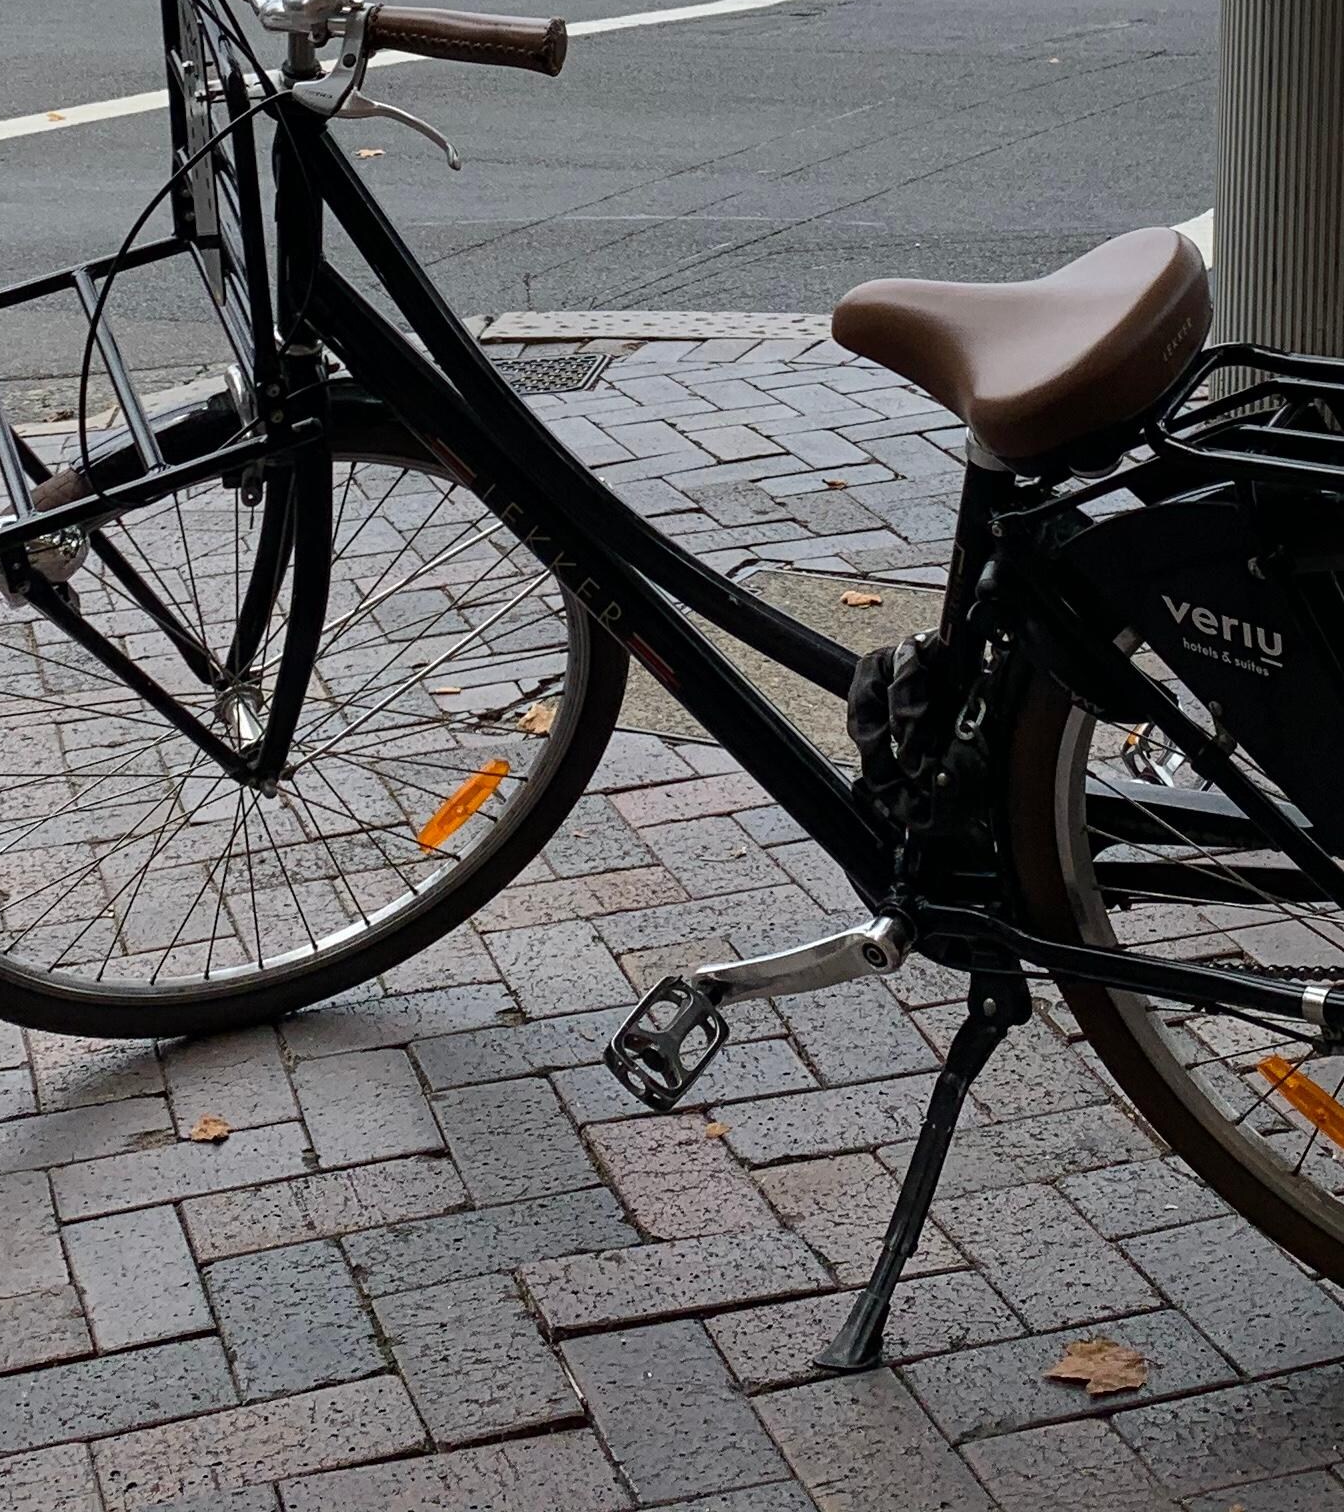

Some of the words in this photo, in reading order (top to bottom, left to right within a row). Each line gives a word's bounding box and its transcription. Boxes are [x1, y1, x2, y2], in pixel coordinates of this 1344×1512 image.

[1183, 637, 1219, 661] hotels
[1221, 651, 1232, 664] &
[1234, 657, 1270, 677] suites
